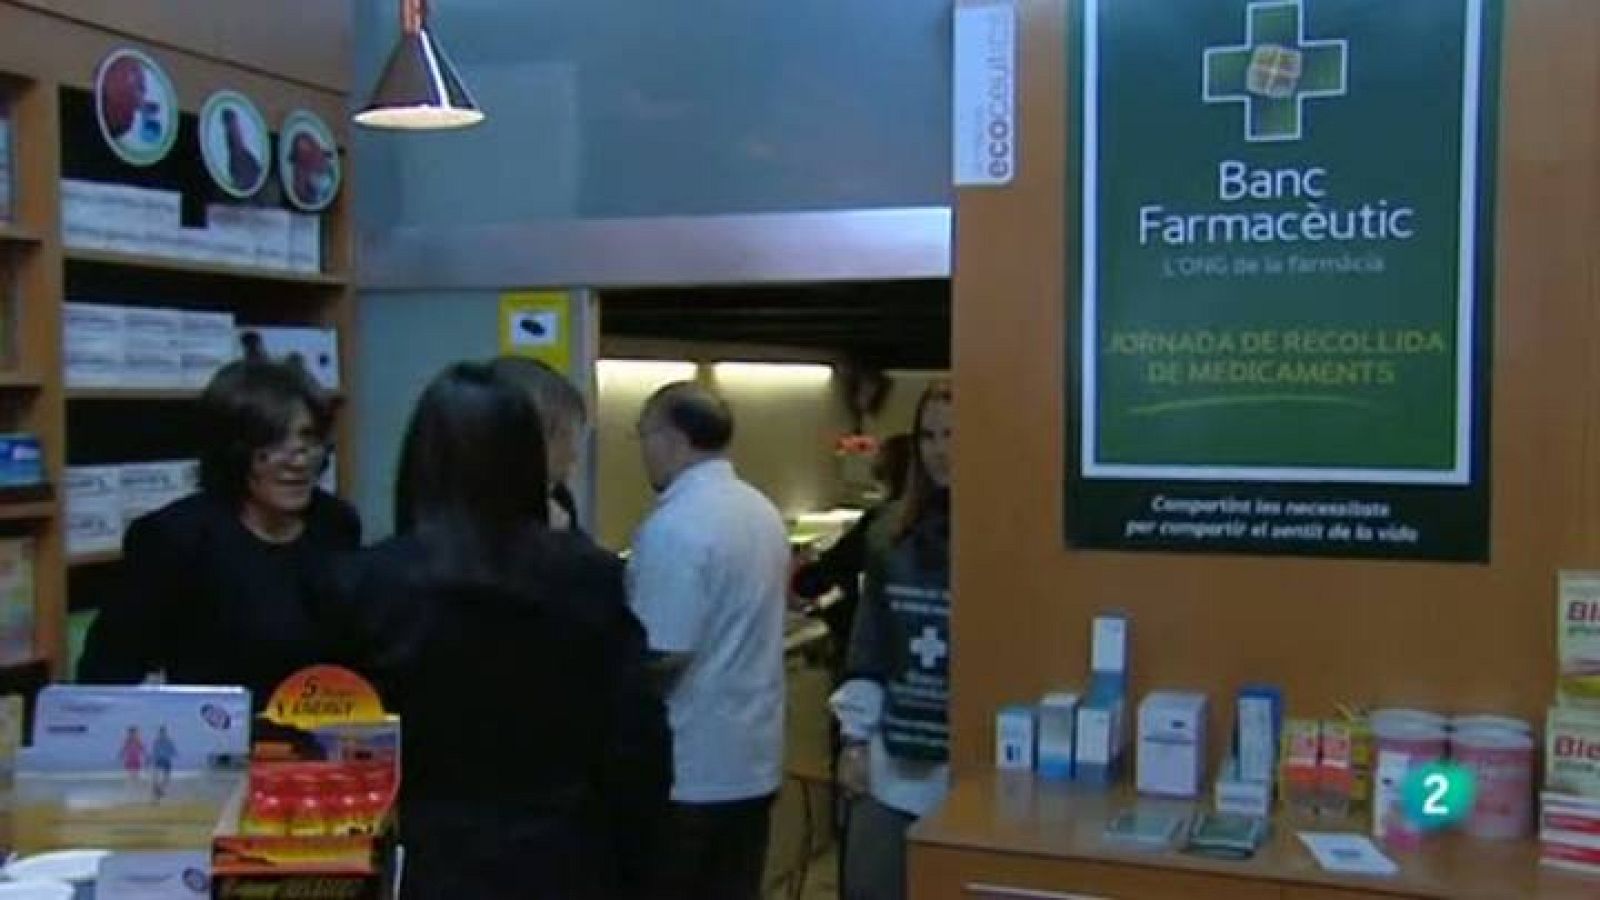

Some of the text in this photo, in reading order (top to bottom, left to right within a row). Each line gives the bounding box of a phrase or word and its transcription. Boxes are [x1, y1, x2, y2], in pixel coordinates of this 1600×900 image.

[1219, 160, 1327, 200] Banc
[1139, 200, 1416, 245] Farmacèutic
[1231, 255, 1259, 276] de
[1262, 254, 1284, 274] la
[1108, 329, 1446, 356] JORNADA DE RECOLLIDA
[1147, 360, 1396, 385] DE MEDICAMENTS
